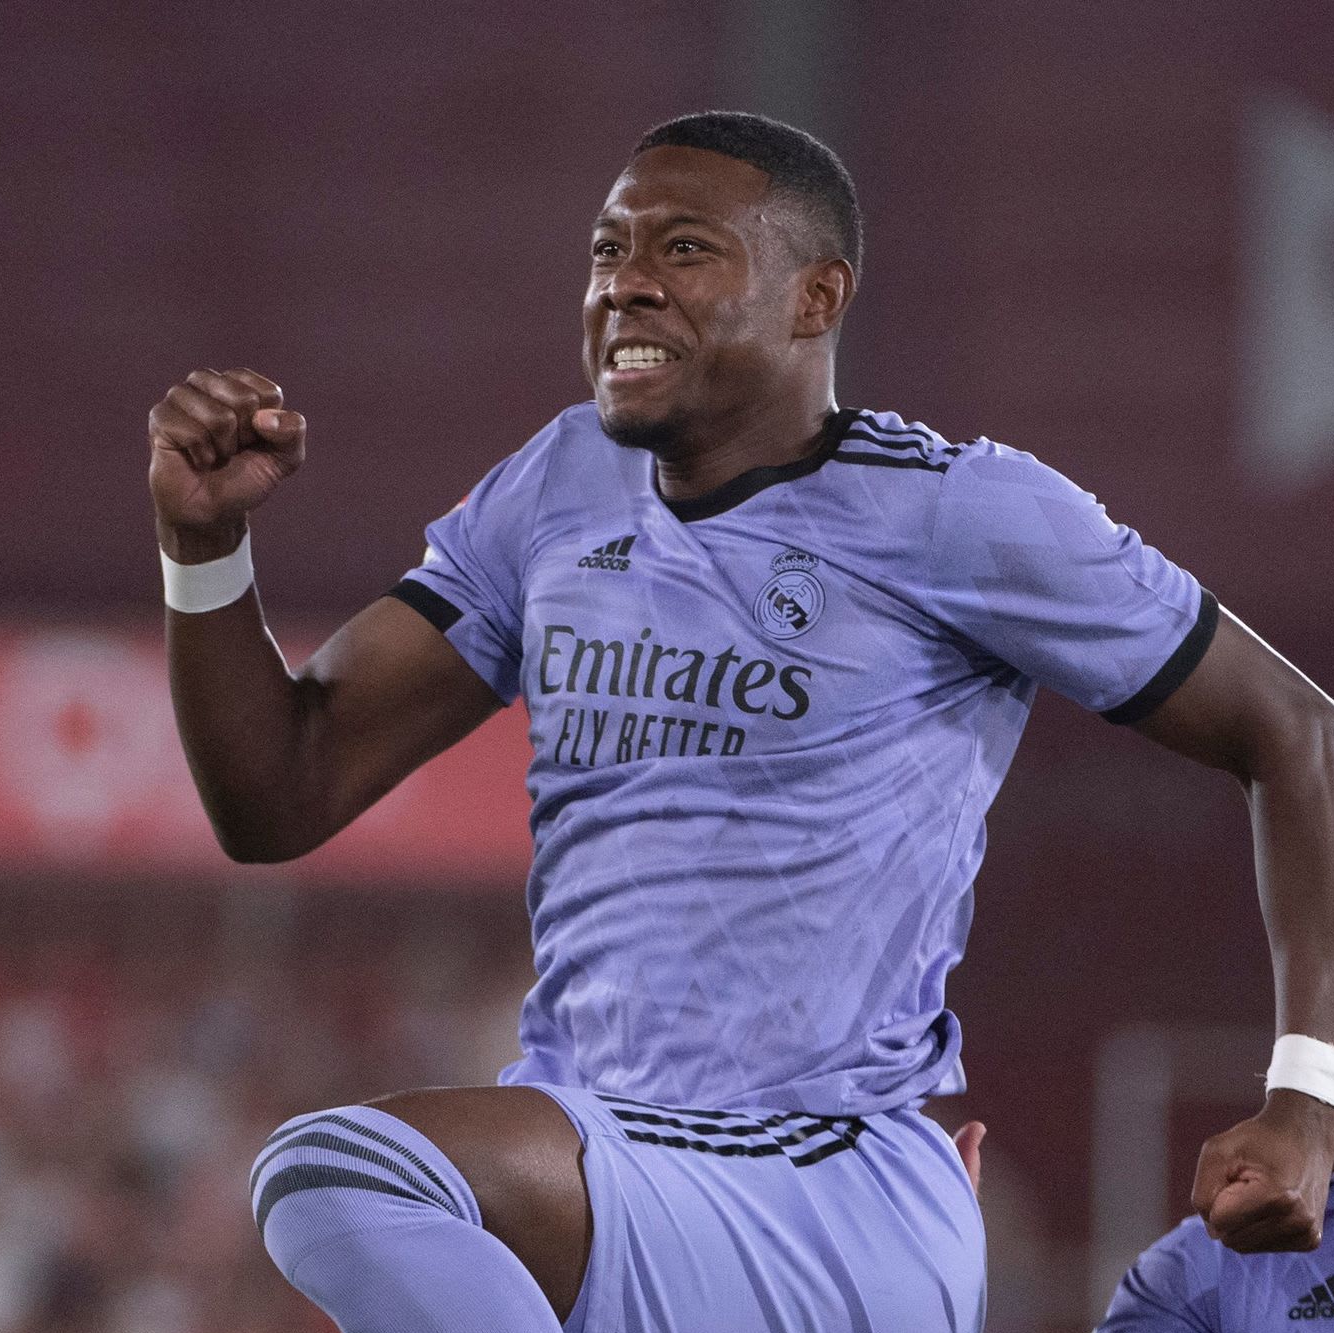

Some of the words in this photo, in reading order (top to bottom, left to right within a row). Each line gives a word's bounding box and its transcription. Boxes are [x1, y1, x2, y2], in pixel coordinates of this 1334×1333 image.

[577, 552, 631, 572] adidas
[540, 624, 812, 721] Emirates
[554, 708, 608, 767] FLY
[617, 712, 746, 765] BETTER
